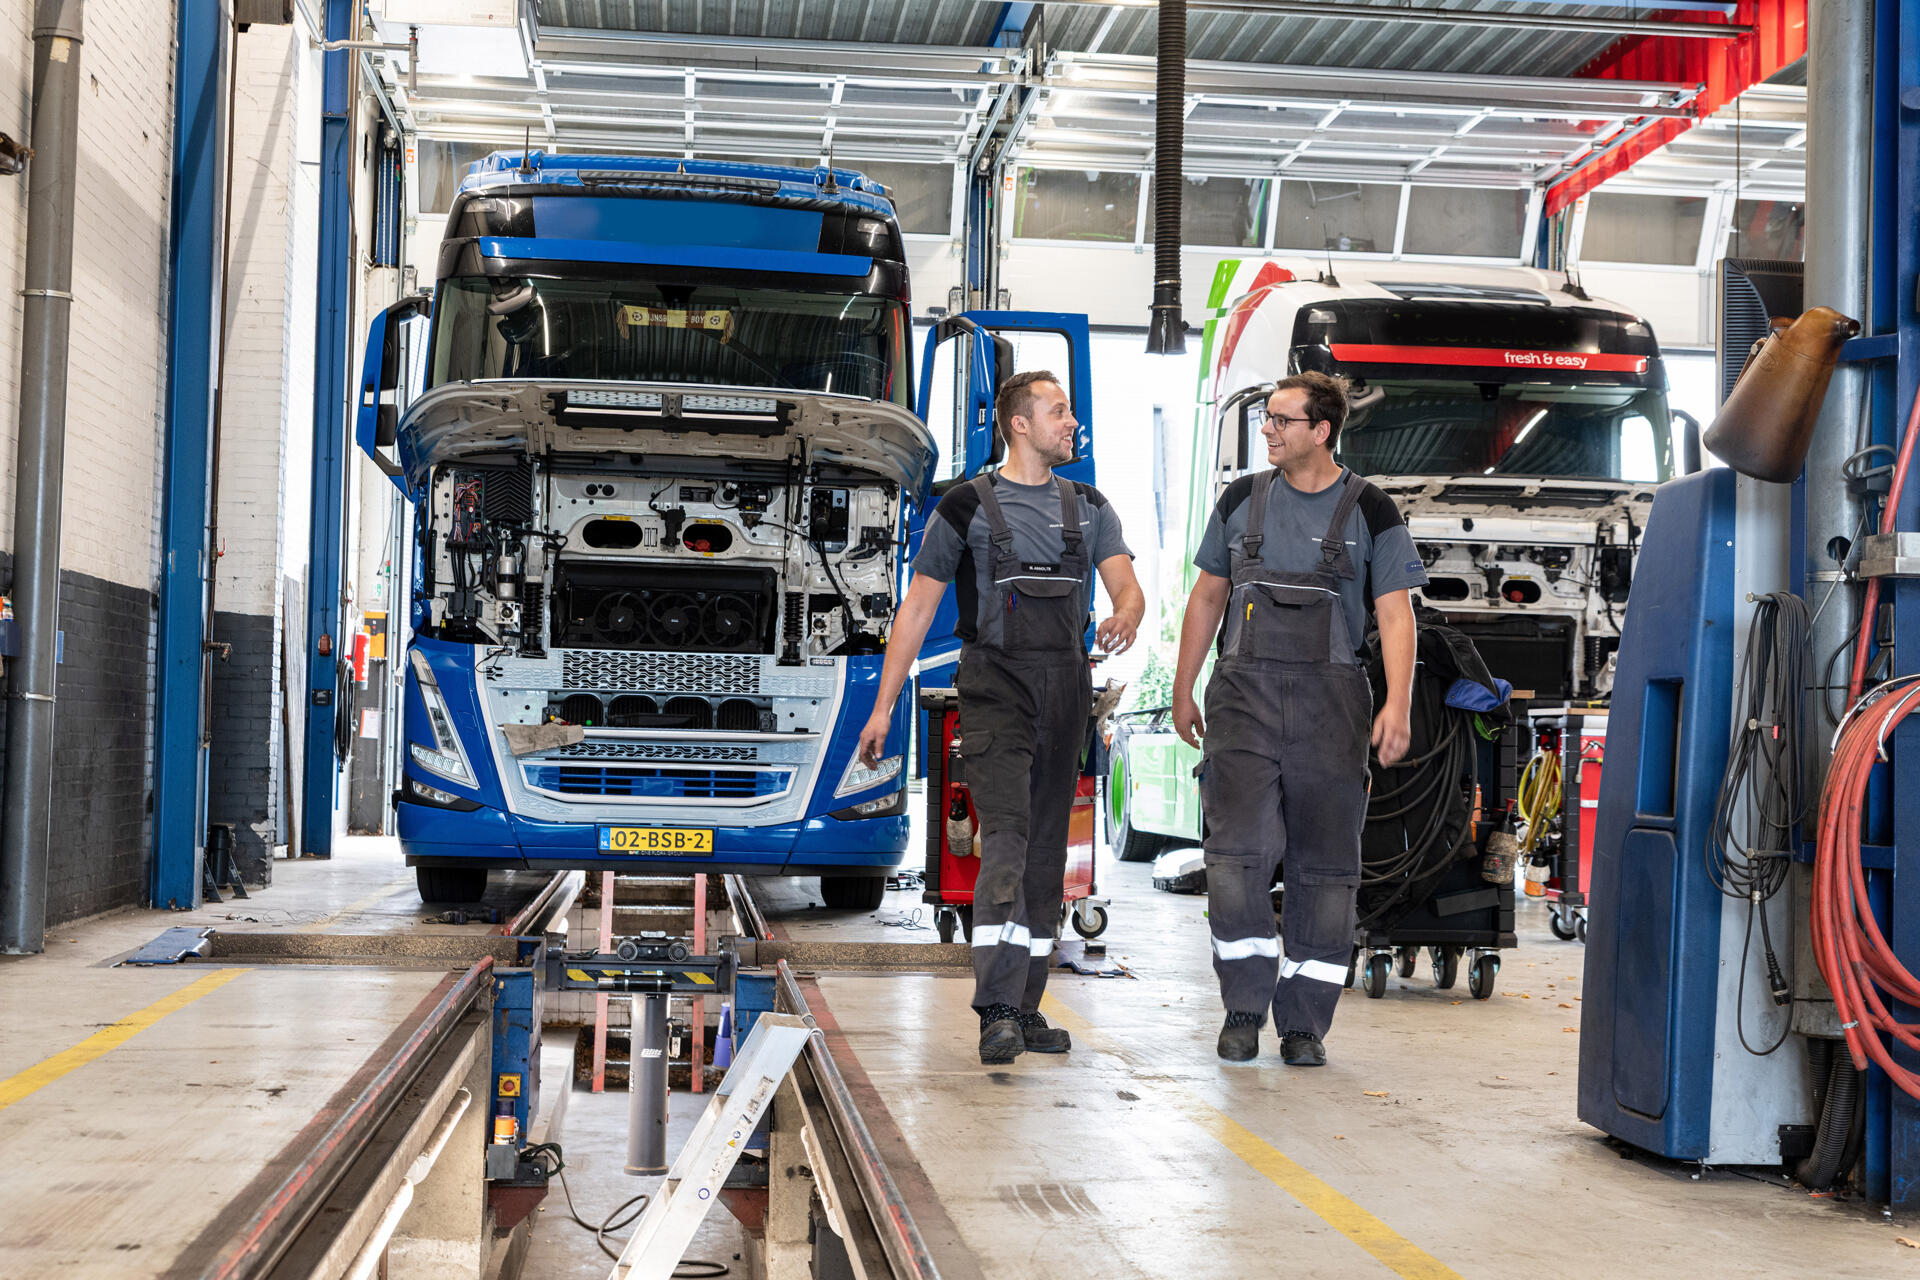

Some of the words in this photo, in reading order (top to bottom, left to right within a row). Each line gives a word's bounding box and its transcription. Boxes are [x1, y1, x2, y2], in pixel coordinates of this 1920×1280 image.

[1504, 352, 1541, 365] fresh
[1542, 353, 1553, 365] &
[1555, 355, 1587, 369] easy
[615, 831, 705, 849] 02-BSB-2
